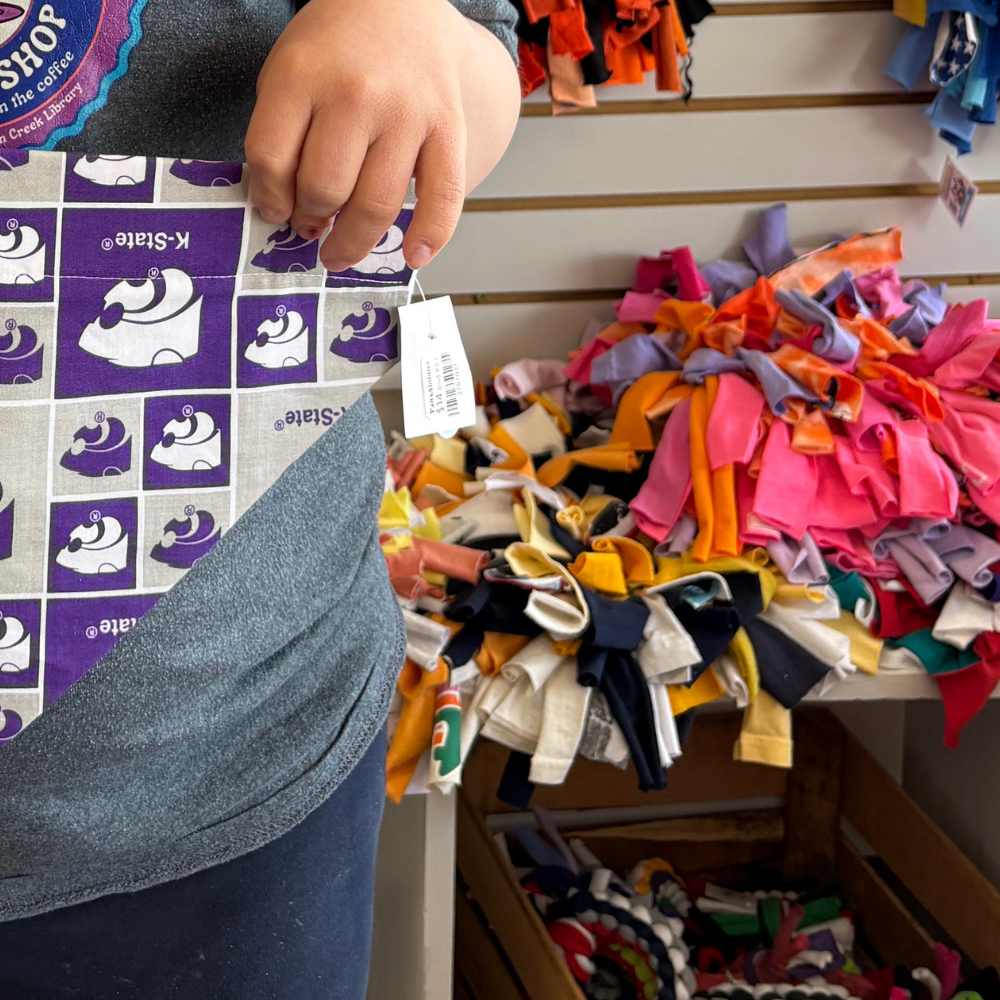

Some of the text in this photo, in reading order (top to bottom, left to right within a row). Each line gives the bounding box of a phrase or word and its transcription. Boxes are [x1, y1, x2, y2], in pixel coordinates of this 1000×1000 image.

[11, 89, 34, 108] the
[37, 50, 75, 94] coffee
[9, 116, 44, 140] Creek
[43, 82, 82, 120] Library
